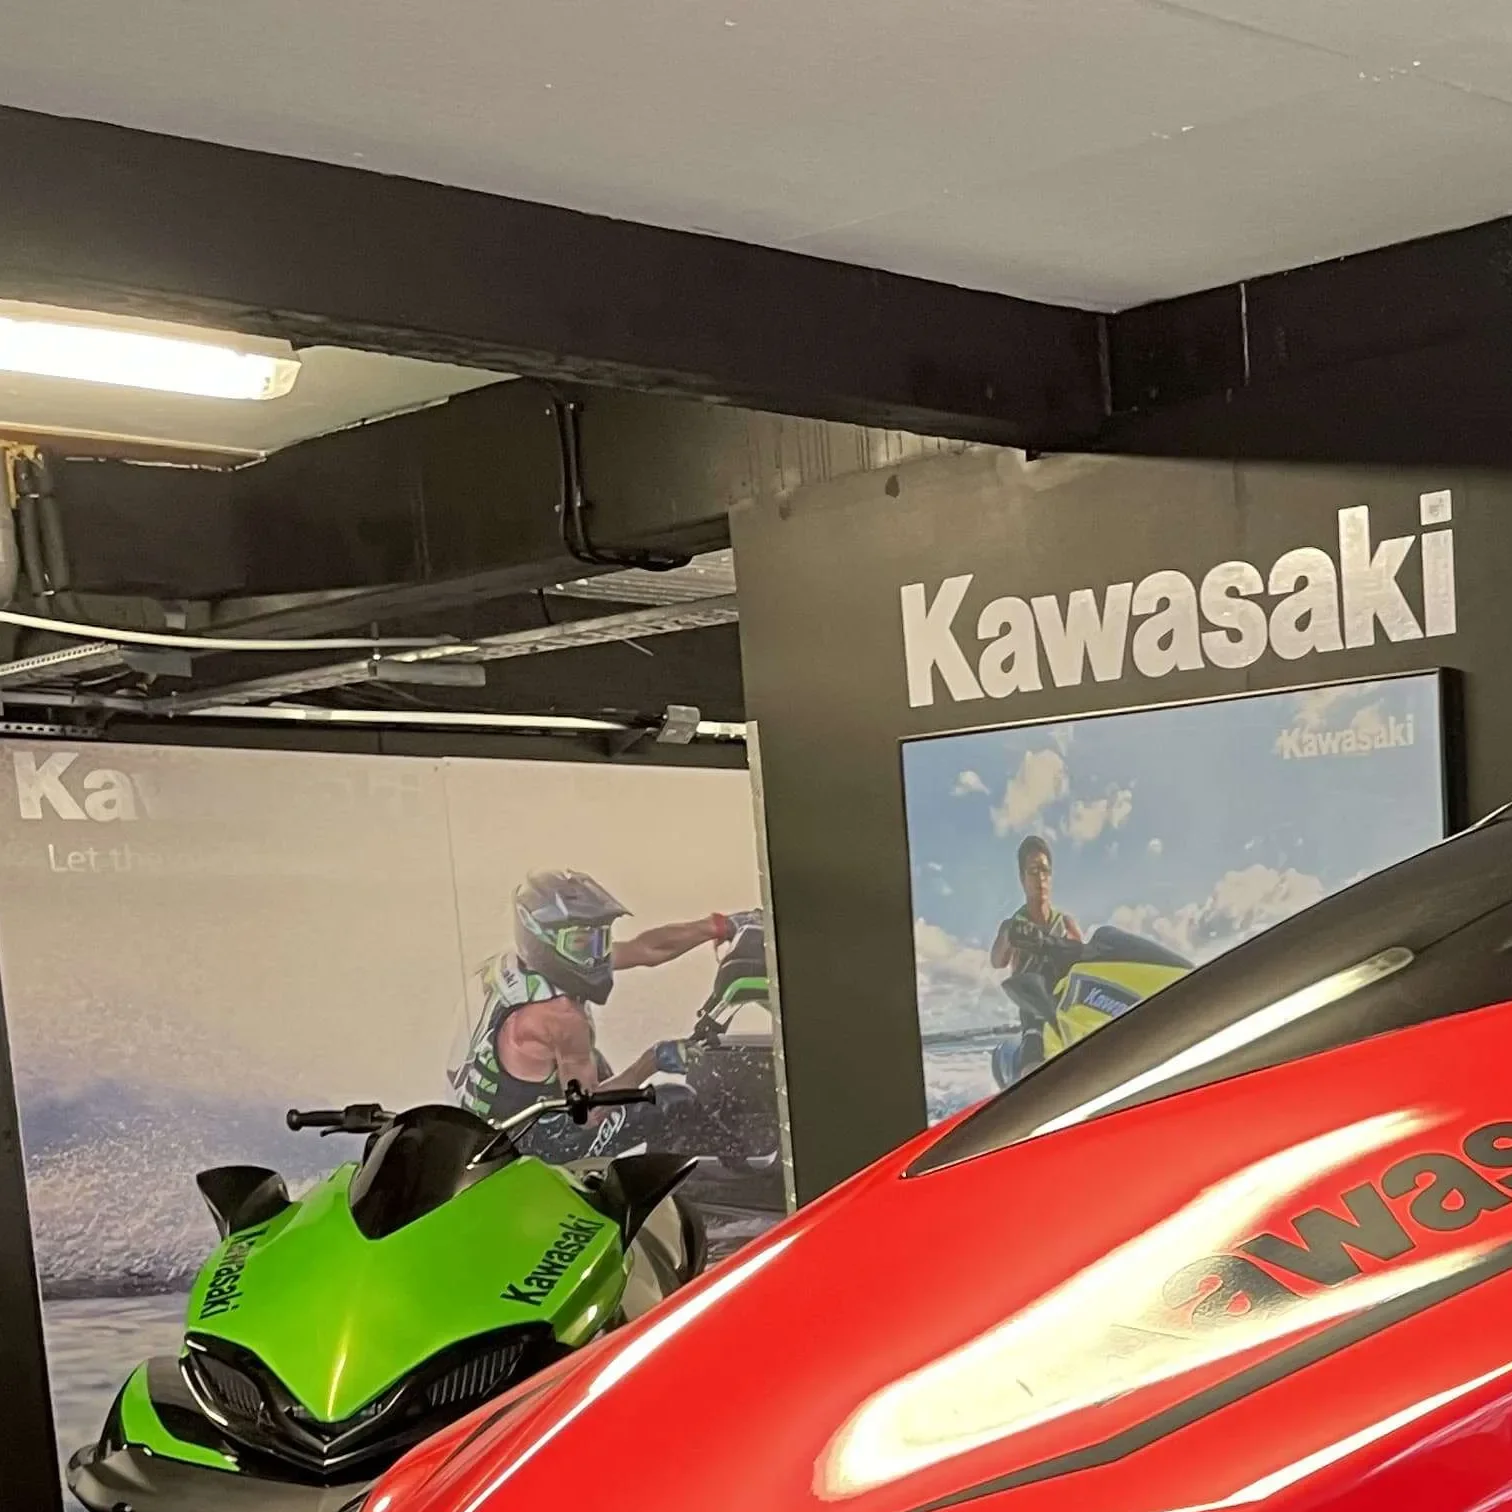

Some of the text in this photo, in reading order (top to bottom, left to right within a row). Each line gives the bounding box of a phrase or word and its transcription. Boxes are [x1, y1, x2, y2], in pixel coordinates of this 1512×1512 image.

[900, 489, 1457, 708] Kawasaki
[1277, 713, 1414, 760] Kawasaki
[48, 843, 99, 872] Let
[199, 1225, 270, 1320] Kawasaki
[500, 1213, 604, 1306] Kawasaki
